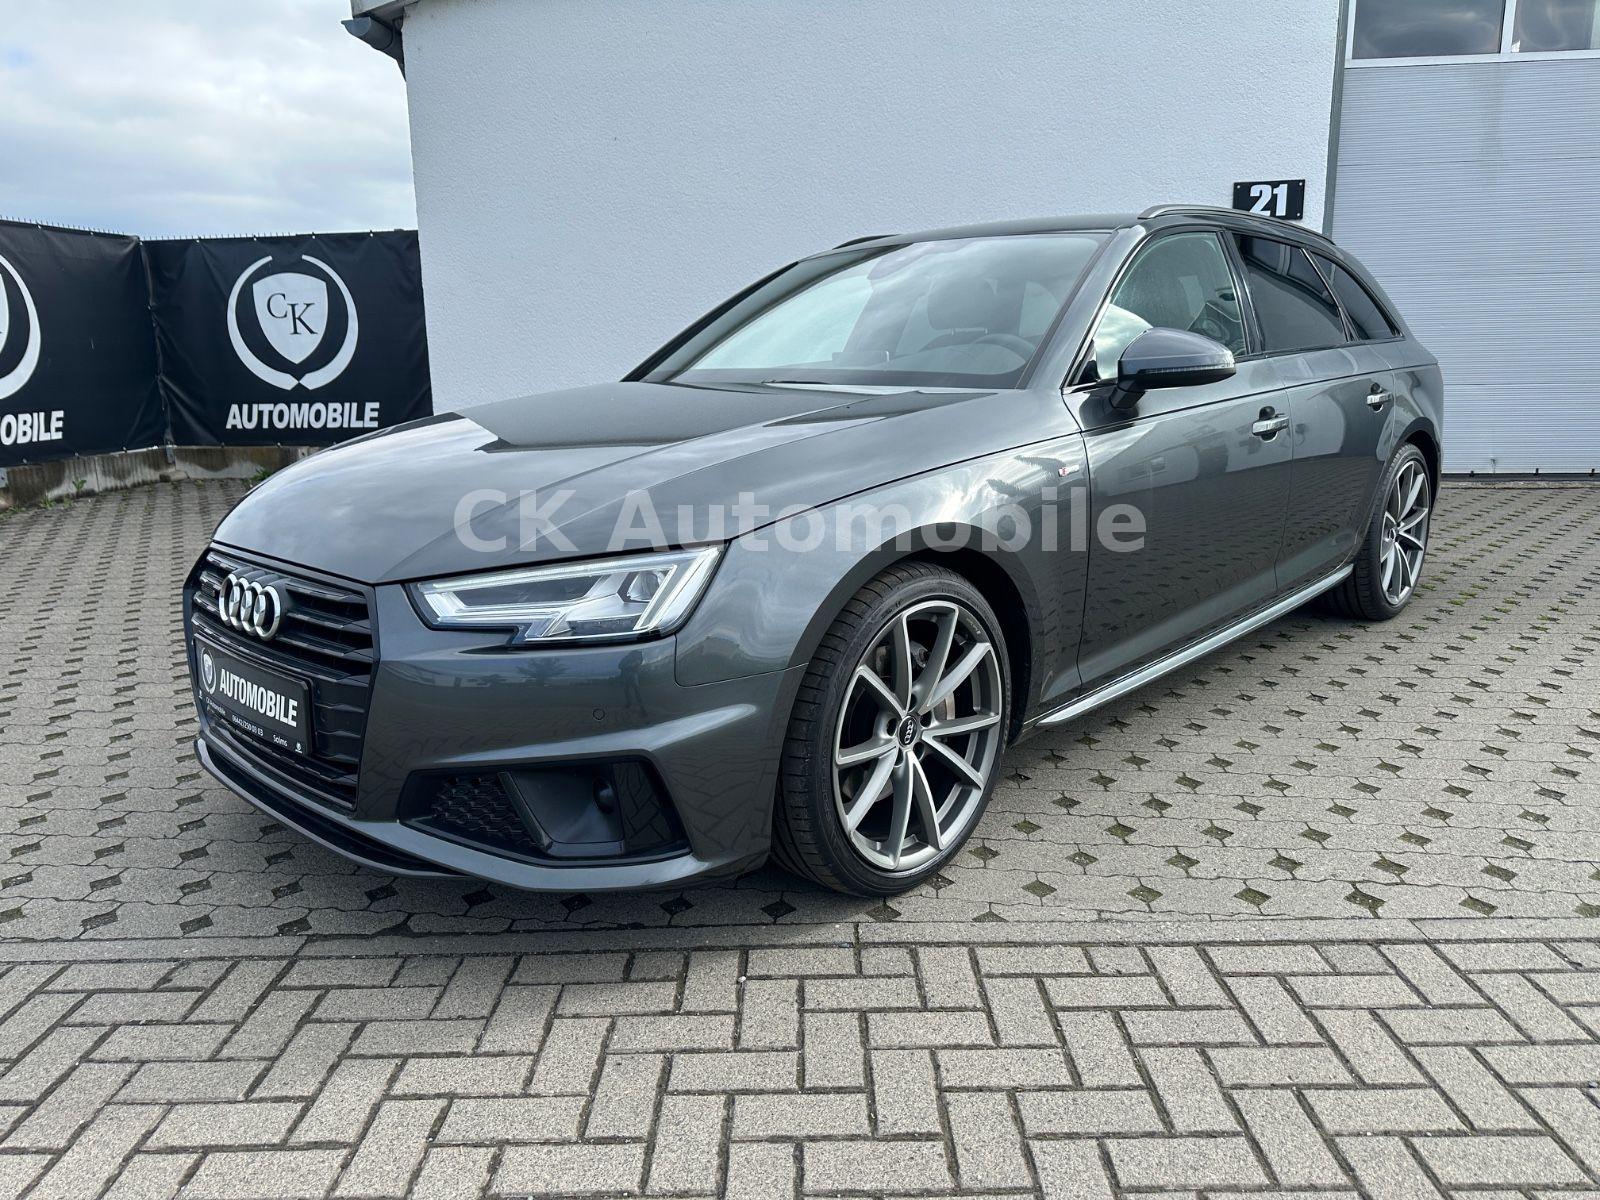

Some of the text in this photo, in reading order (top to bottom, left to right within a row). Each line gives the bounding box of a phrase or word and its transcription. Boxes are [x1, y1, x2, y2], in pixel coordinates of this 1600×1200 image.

[1249, 184, 1288, 217] 21
[266, 292, 318, 335] CK
[0, 410, 64, 445] OBILE
[226, 402, 380, 429] AUTOMOBILE
[220, 668, 298, 728] AUTOMOBILE
